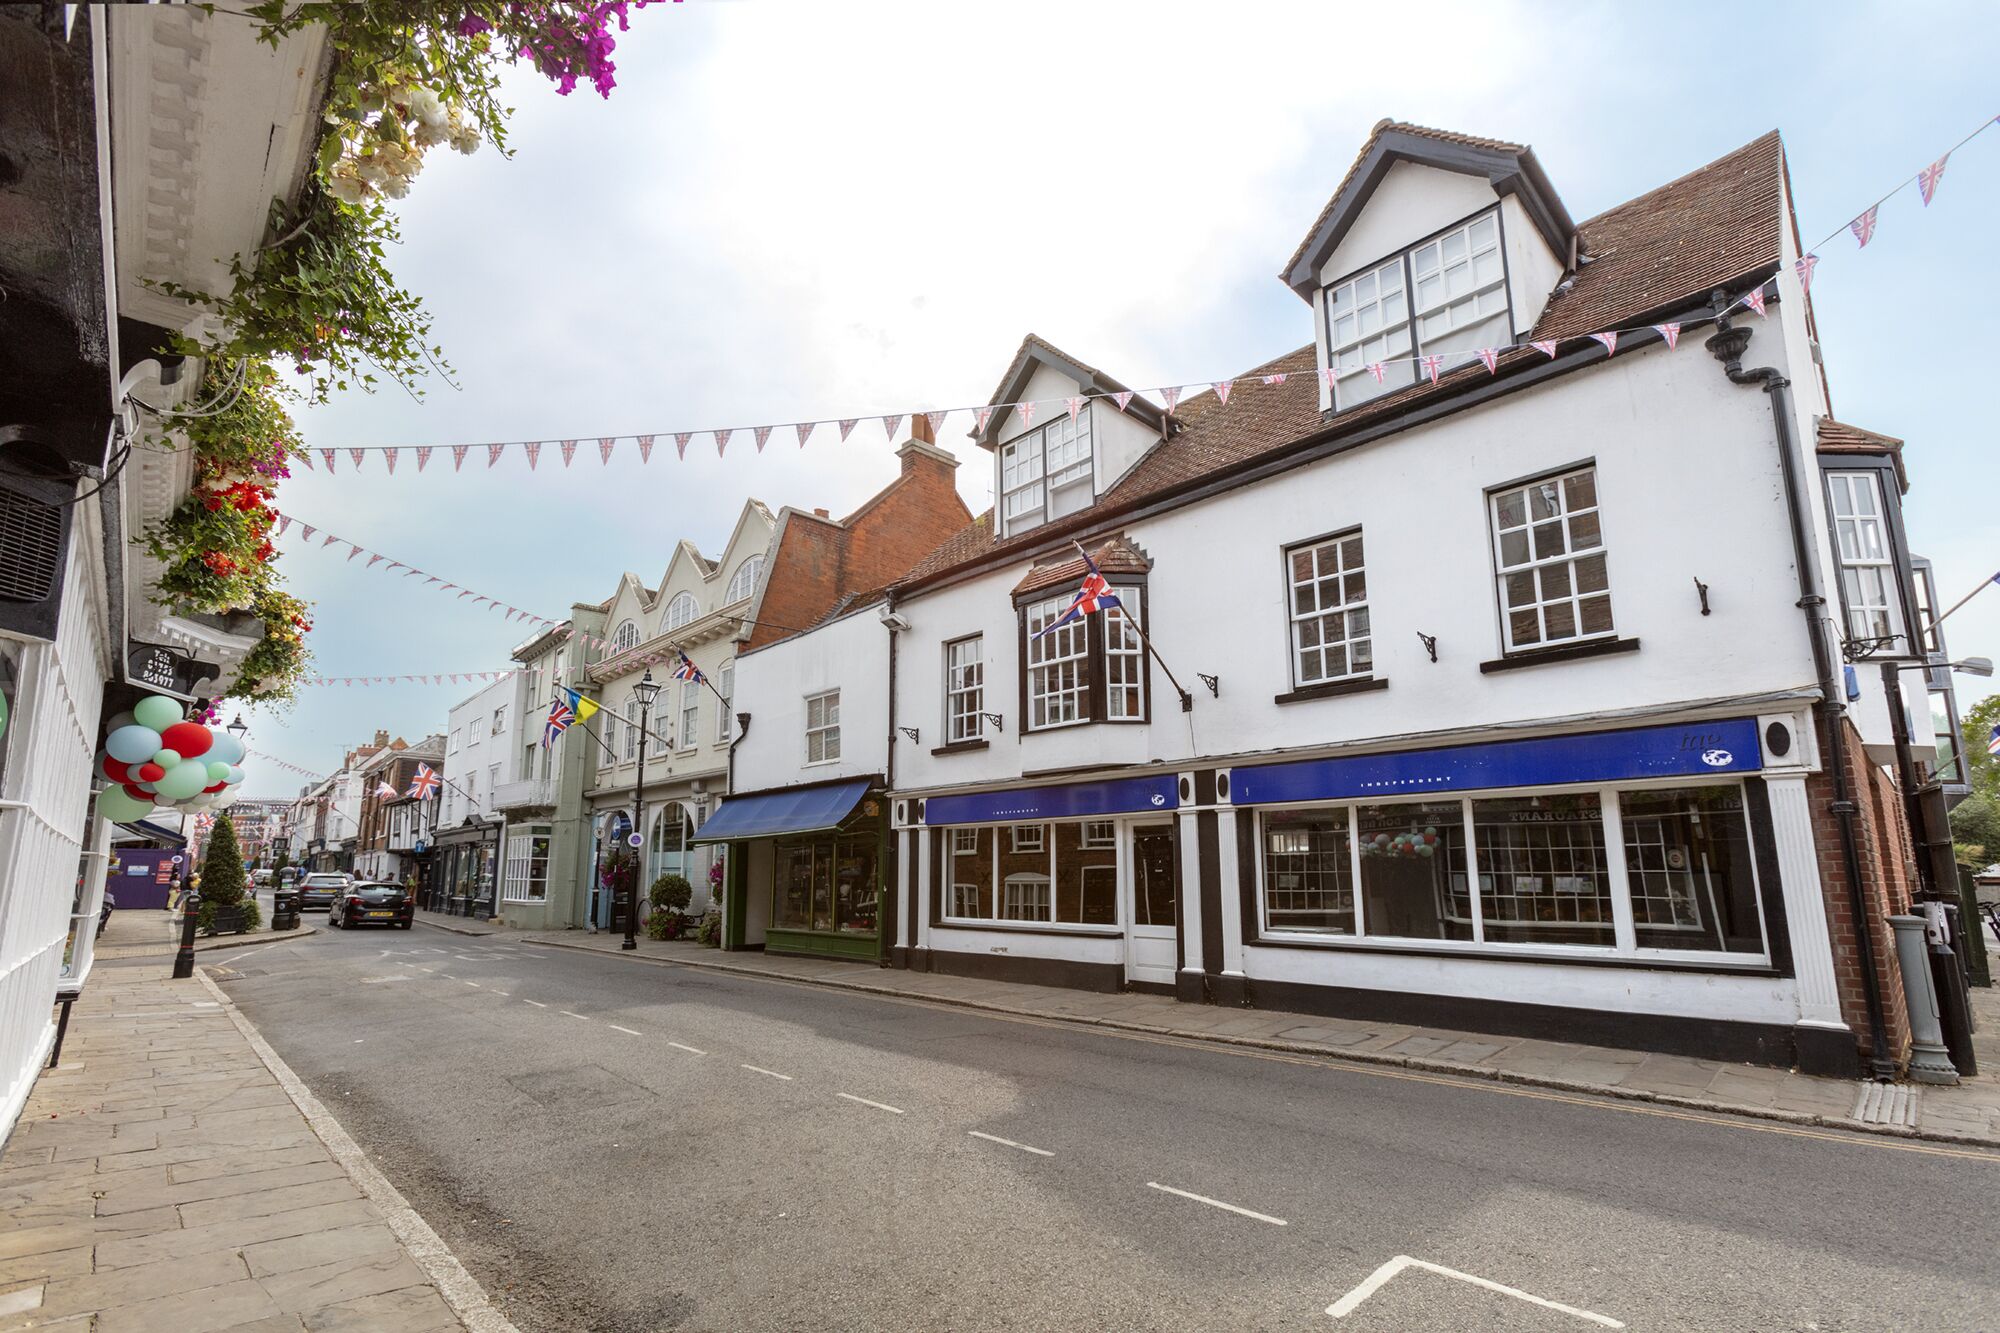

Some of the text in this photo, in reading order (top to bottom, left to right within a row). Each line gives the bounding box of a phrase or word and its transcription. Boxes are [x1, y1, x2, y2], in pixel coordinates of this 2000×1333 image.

[147, 659, 173, 676] 01753
[143, 670, 174, 687] 863977
[1360, 777, 1451, 788] INDEPENDENT
